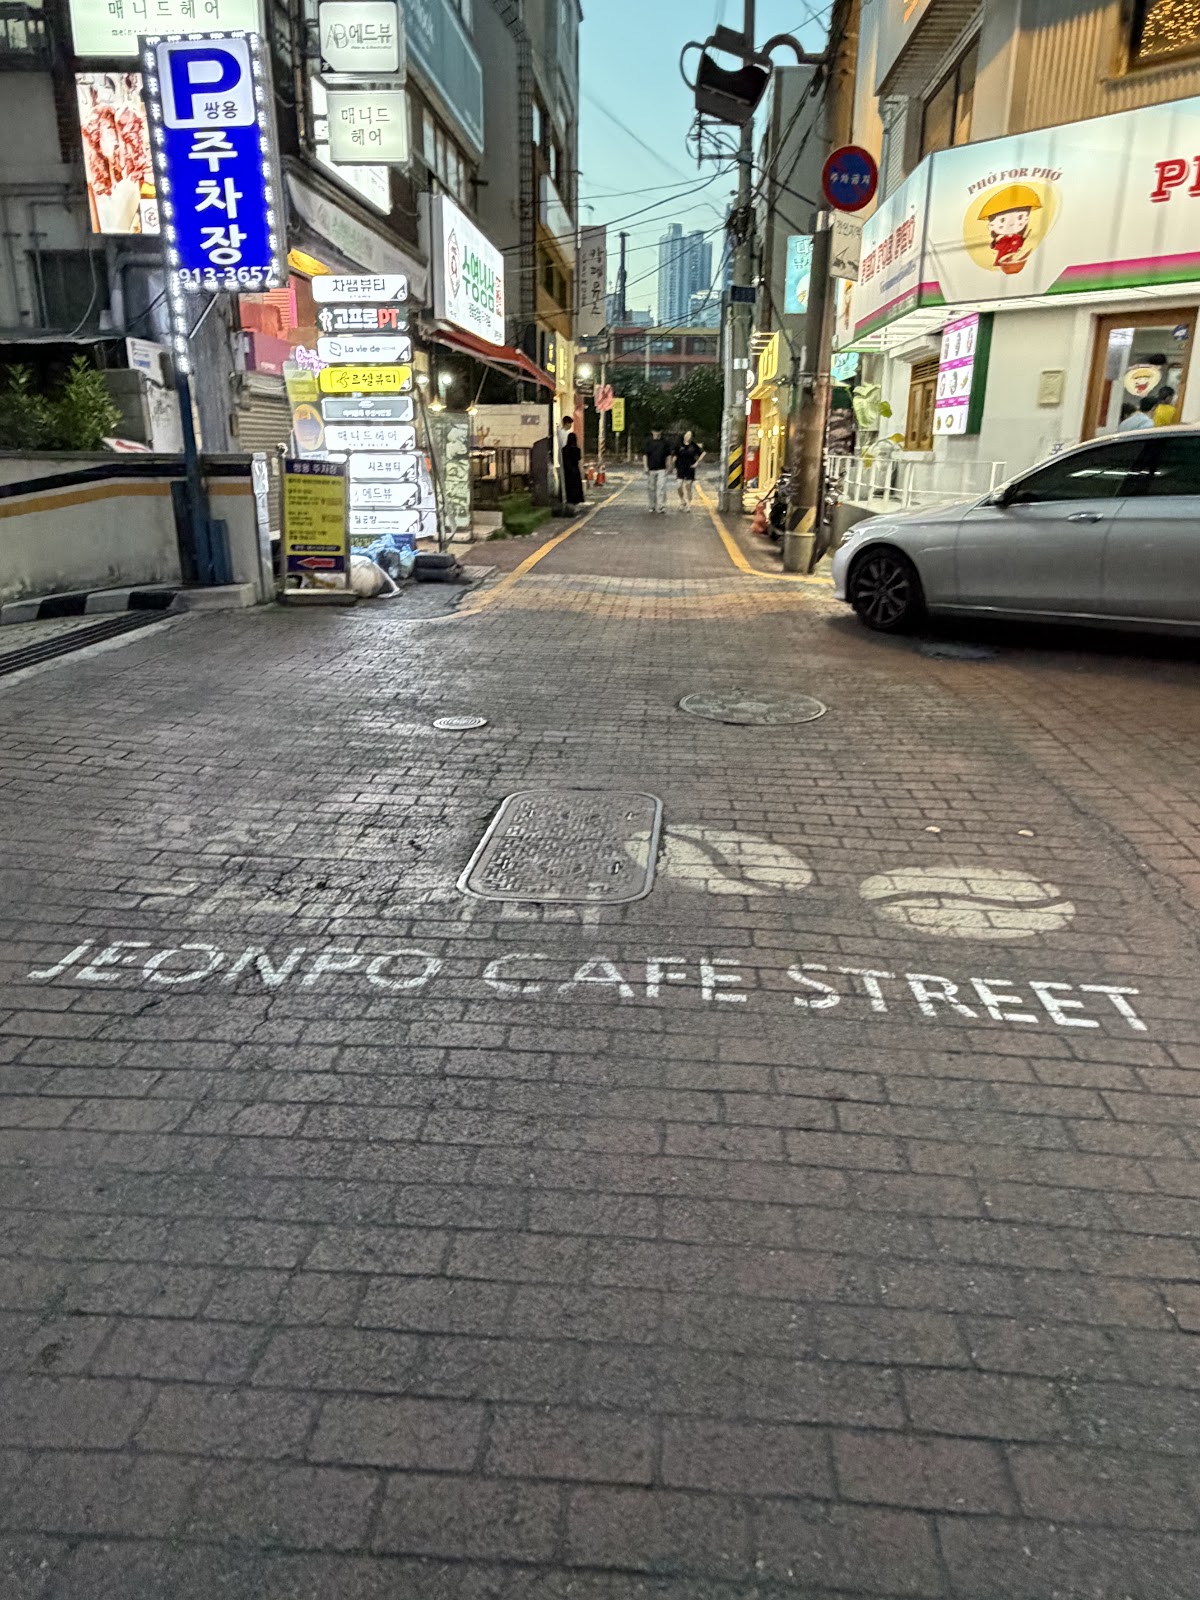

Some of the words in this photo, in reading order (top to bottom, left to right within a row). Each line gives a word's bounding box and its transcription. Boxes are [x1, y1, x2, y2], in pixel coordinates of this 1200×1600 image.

[108, 0, 220, 19] 매니드헤어
[349, 24, 392, 43] 에드뷰
[168, 48, 241, 120] P
[205, 101, 238, 119] 쌍용
[341, 107, 390, 124] 매니드
[351, 129, 382, 145] 헤어
[1000, 167, 1029, 182] FOR
[188, 131, 248, 265] 주차장
[178, 266, 273, 284] 913-3657
[333, 278, 386, 293] 차쌤뷰티
[27, 939, 443, 989] JEONPO
[482, 953, 748, 1003] CAFE
[786, 962, 1148, 1031] STREET
